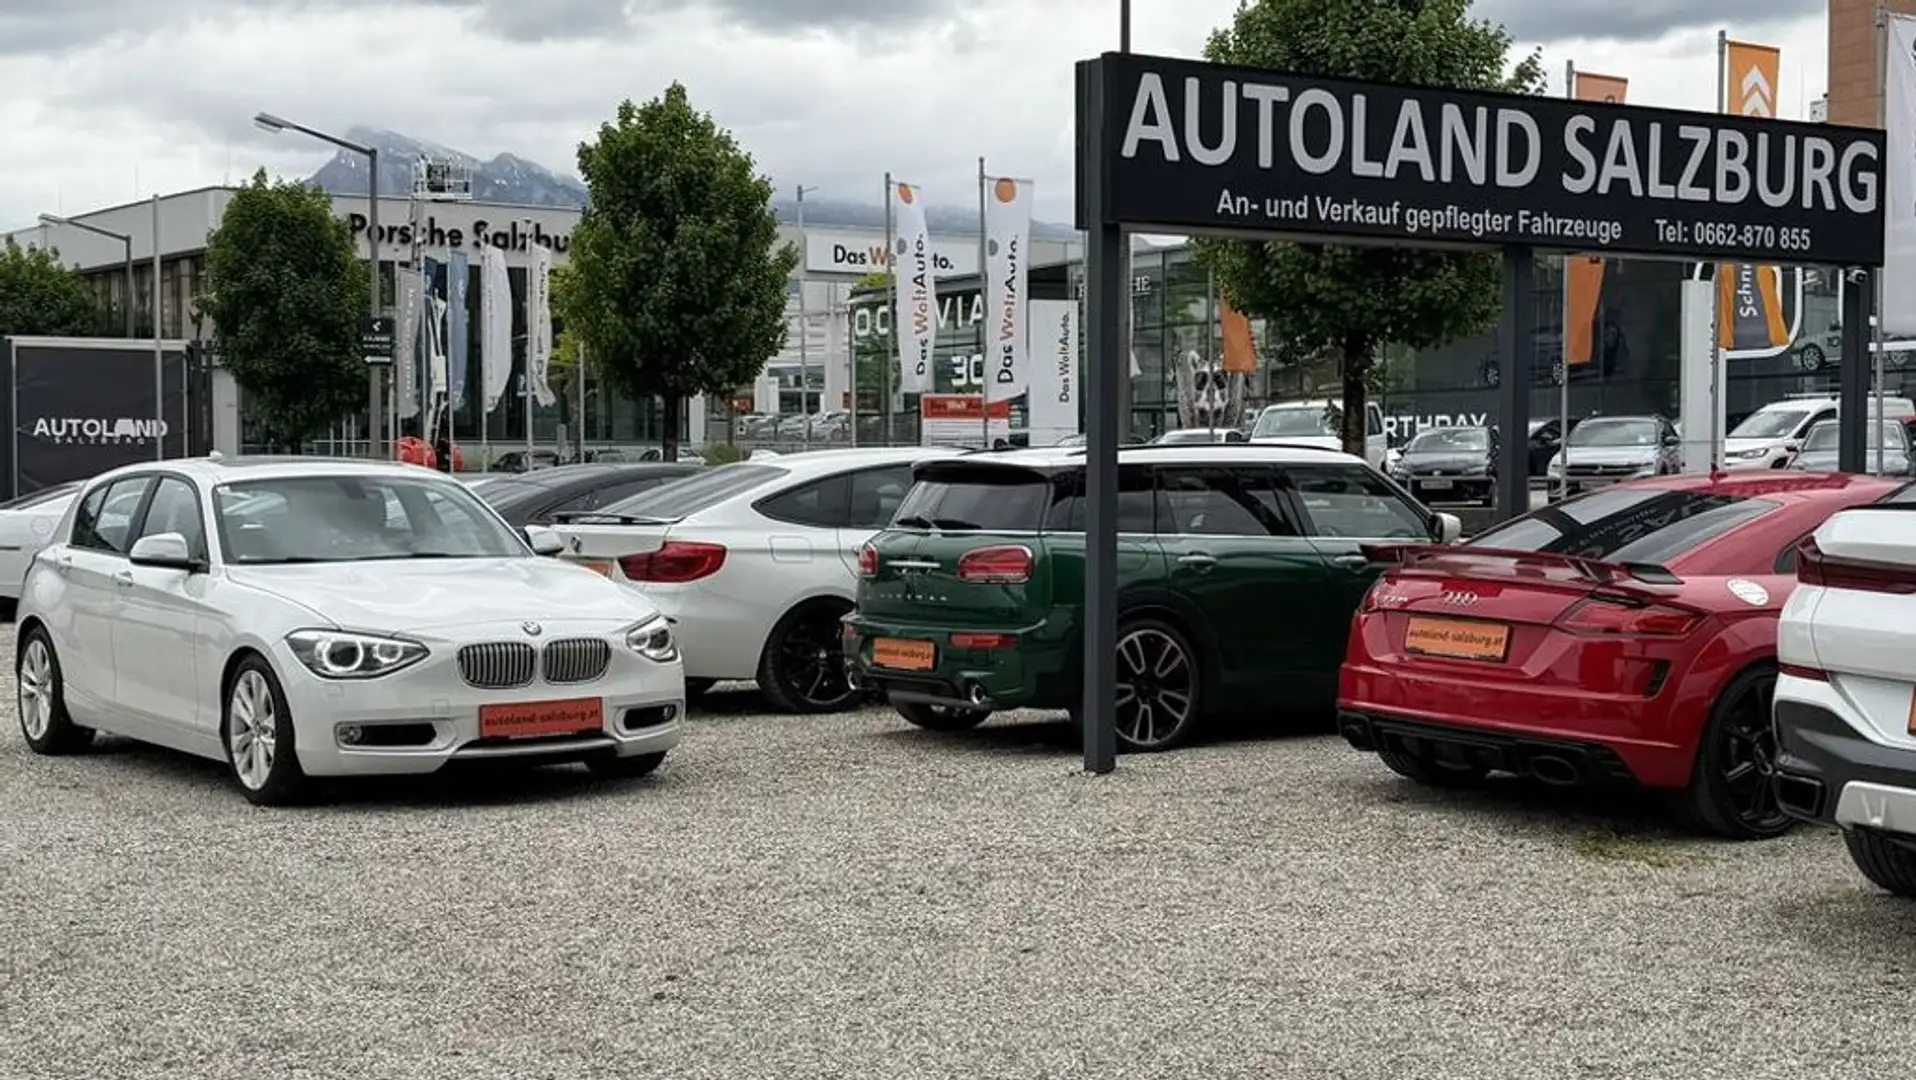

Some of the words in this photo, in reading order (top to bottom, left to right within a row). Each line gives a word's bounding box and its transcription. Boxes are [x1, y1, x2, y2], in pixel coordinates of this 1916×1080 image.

[1120, 72, 1541, 188] AUTOLAND
[1562, 114, 1878, 214] SALZBURG
[1217, 189, 1258, 215] An-
[1266, 195, 1308, 219] und
[1316, 196, 1401, 226] Verkauf
[1405, 204, 1512, 236] gepflegter
[1518, 210, 1623, 243] Fahrzeuge
[1656, 219, 1689, 243] Tel:
[1694, 221, 1775, 248] 0662-870
[1780, 227, 1811, 250] 855
[834, 244, 866, 264] Das
[855, 294, 984, 337] OCVIA
[914, 338, 928, 375] Das
[997, 344, 1014, 384] Das
[1059, 377, 1070, 403] Das
